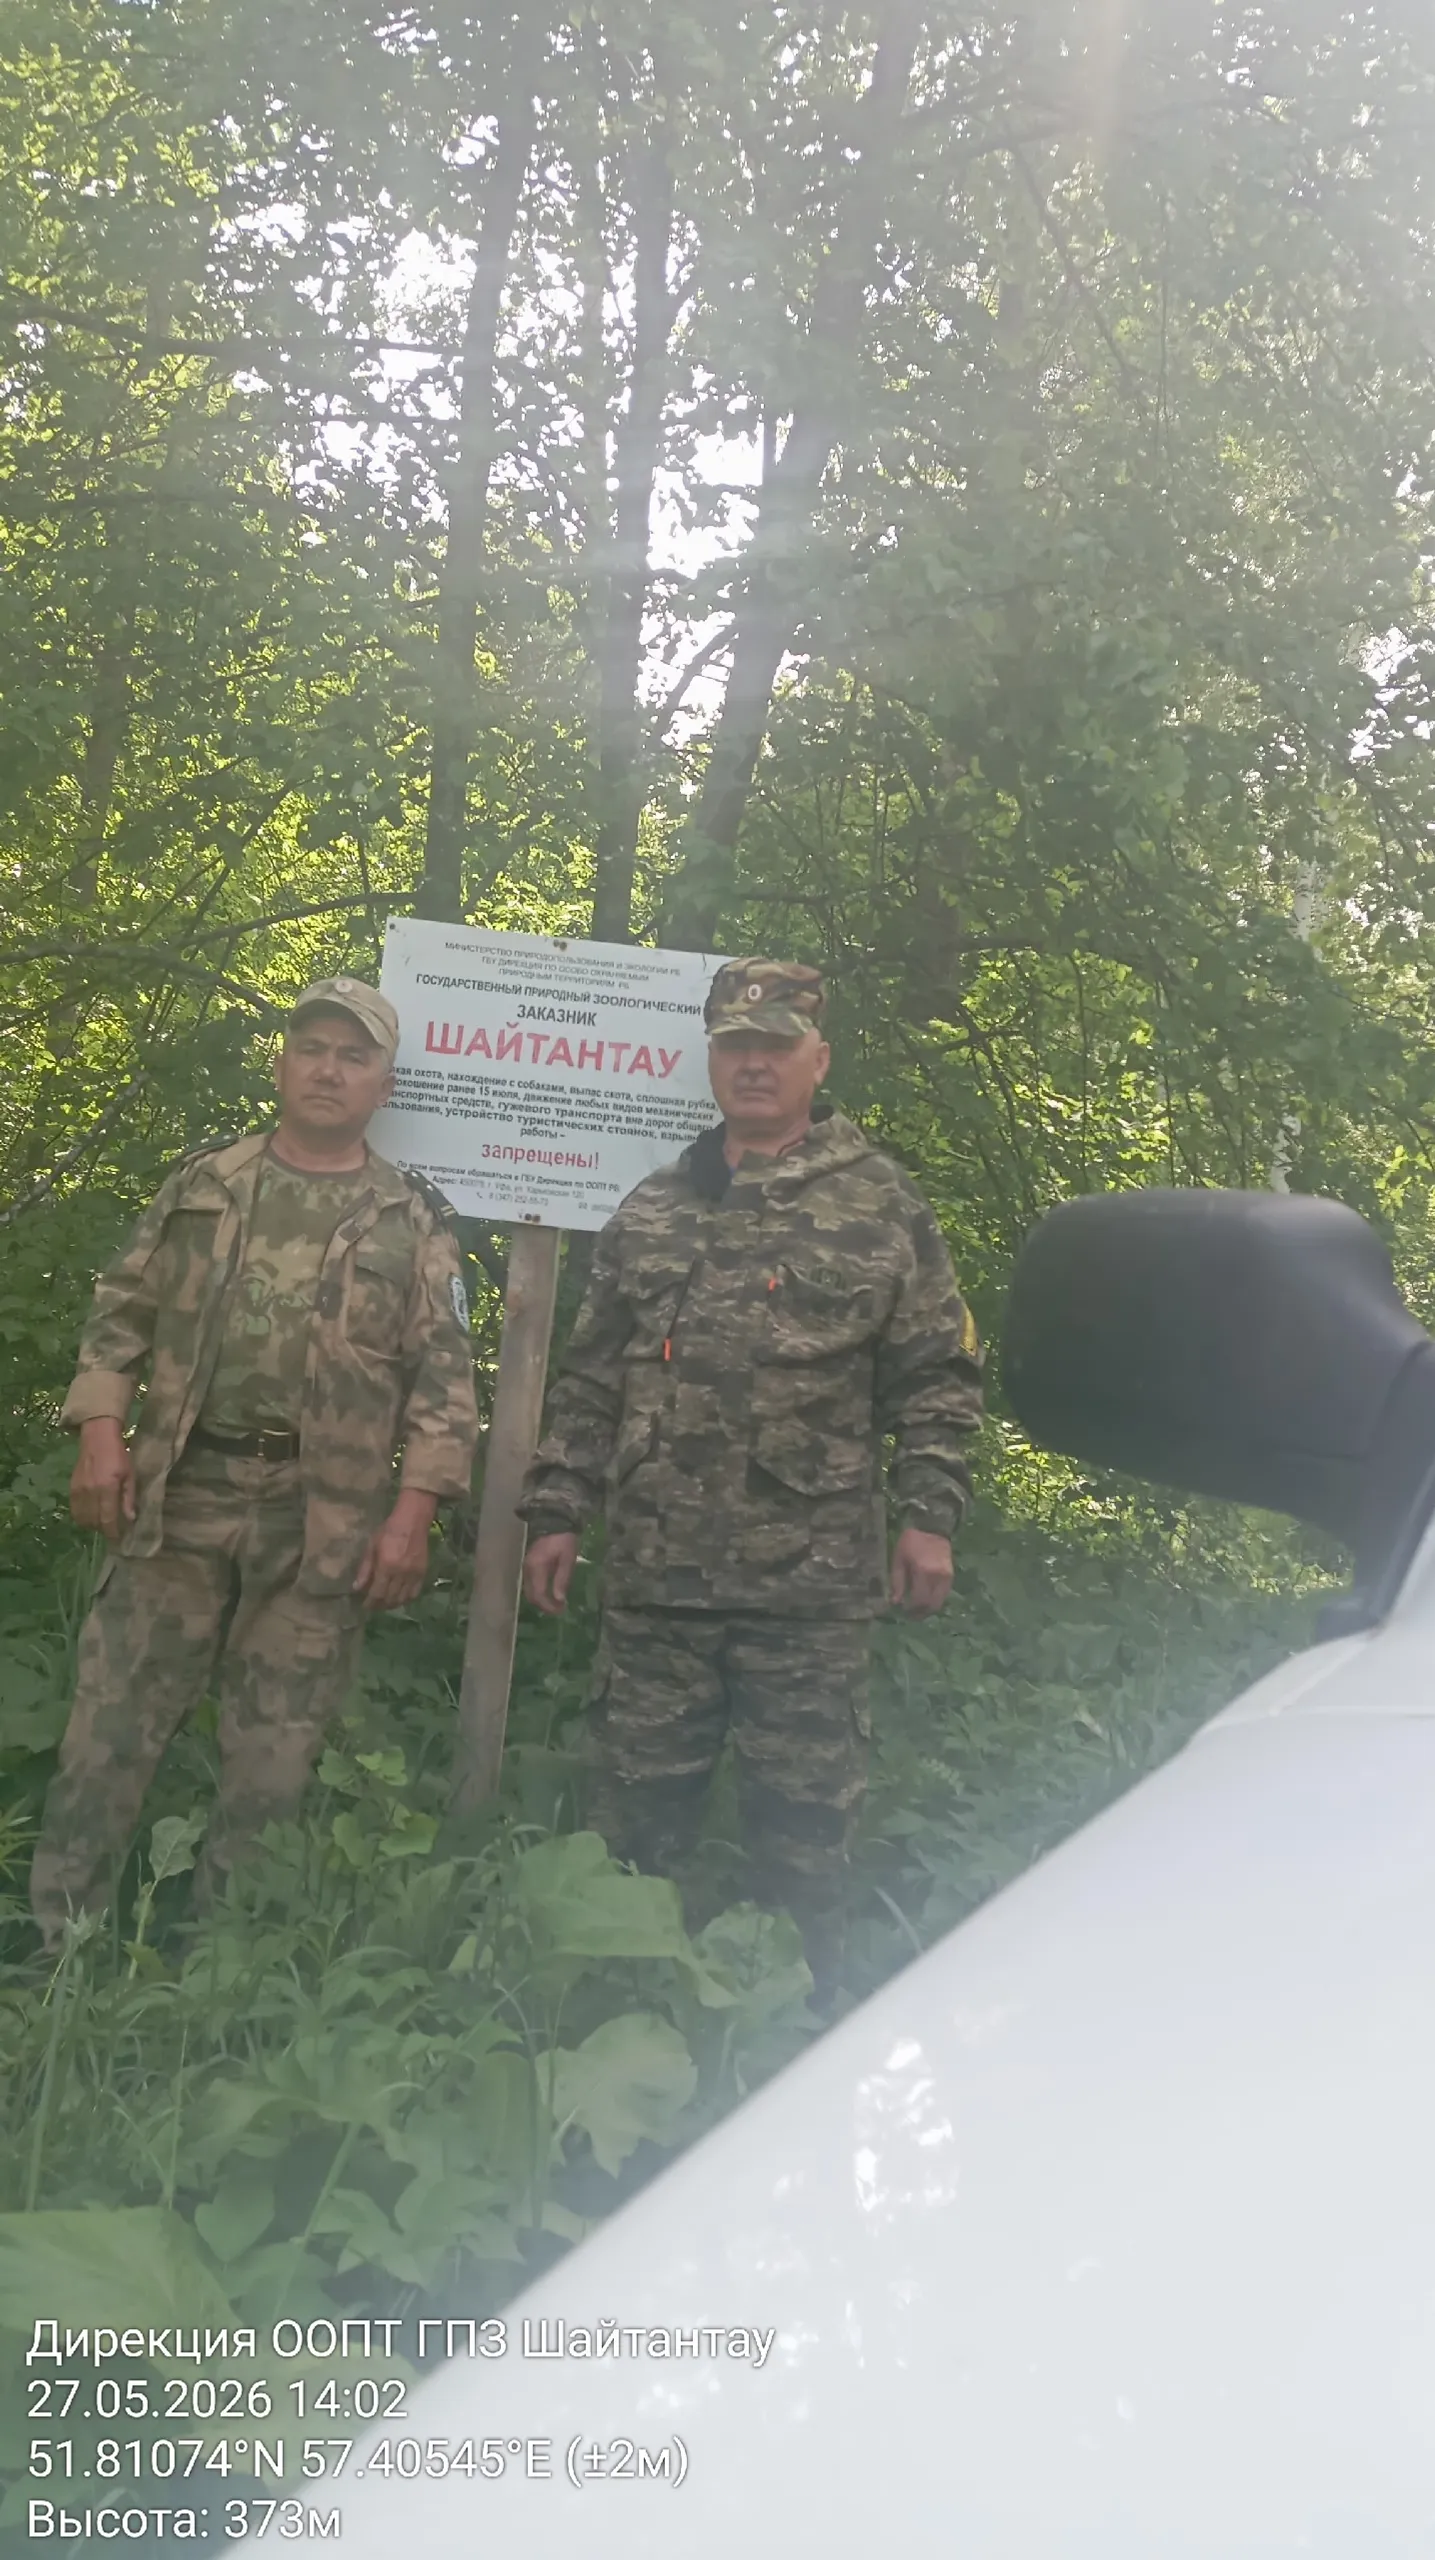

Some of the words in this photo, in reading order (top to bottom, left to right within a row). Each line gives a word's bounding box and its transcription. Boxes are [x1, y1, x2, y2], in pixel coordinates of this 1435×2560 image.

[445, 942, 512, 957] МИНИСТЕРСТВО
[514, 950, 615, 968] ПРИРОДОПОЛЬЗОВАНИЯ
[624, 963, 668, 975] ЭКОЛОГИИ
[498, 959, 543, 971] ДИРЕКЦИЯ
[545, 964, 557, 972] ПО
[559, 965, 589, 975] ОСОБО
[416, 973, 522, 996] ГОСУДАРСТВЕННЫЙ
[524, 986, 592, 1004] ПРИРОДНЫЙ
[593, 994, 702, 1016] ЗООЛОГИЧЕСКИЙ
[499, 968, 553, 981] ПРИРОДНЫМ
[554, 975, 615, 988] ТЕРРИТОРИЯМ
[517, 1004, 597, 1027] ЗАКАЗНИК
[425, 1021, 683, 1079] ШАЙТАНТАУ
[414, 1068, 445, 1080] охота,
[447, 1073, 508, 1087] нахождение
[517, 1080, 567, 1095] собаками,
[570, 1086, 602, 1098] выпас
[603, 1091, 634, 1102] скота,
[636, 1094, 686, 1107] сплошная
[688, 1099, 720, 1112] рубка,
[447, 1084, 476, 1095] ранее
[479, 1086, 490, 1096] 15
[492, 1090, 520, 1101] июля,
[523, 1093, 573, 1106] движение
[575, 1099, 610, 1110] любых
[613, 1103, 643, 1114] видов
[646, 1106, 714, 1121] механических
[445, 1106, 514, 1122] устройство
[517, 1114, 604, 1133] туристических
[607, 1126, 658, 1140] стоянок,
[452, 1095, 495, 1110] средств,
[498, 1101, 552, 1115] гужевого
[555, 1107, 624, 1123] транспорта
[625, 1115, 643, 1124] вне
[645, 1118, 674, 1130] дорог
[520, 1126, 559, 1139] работы
[482, 1144, 599, 1170] запрещены!
[397, 1160, 408, 1168] По
[409, 1163, 427, 1171] всем
[429, 1165, 466, 1176] вопросам
[467, 1168, 513, 1180] обращаться
[536, 1176, 573, 1188] Дирекция
[585, 1180, 607, 1191] ООПТ
